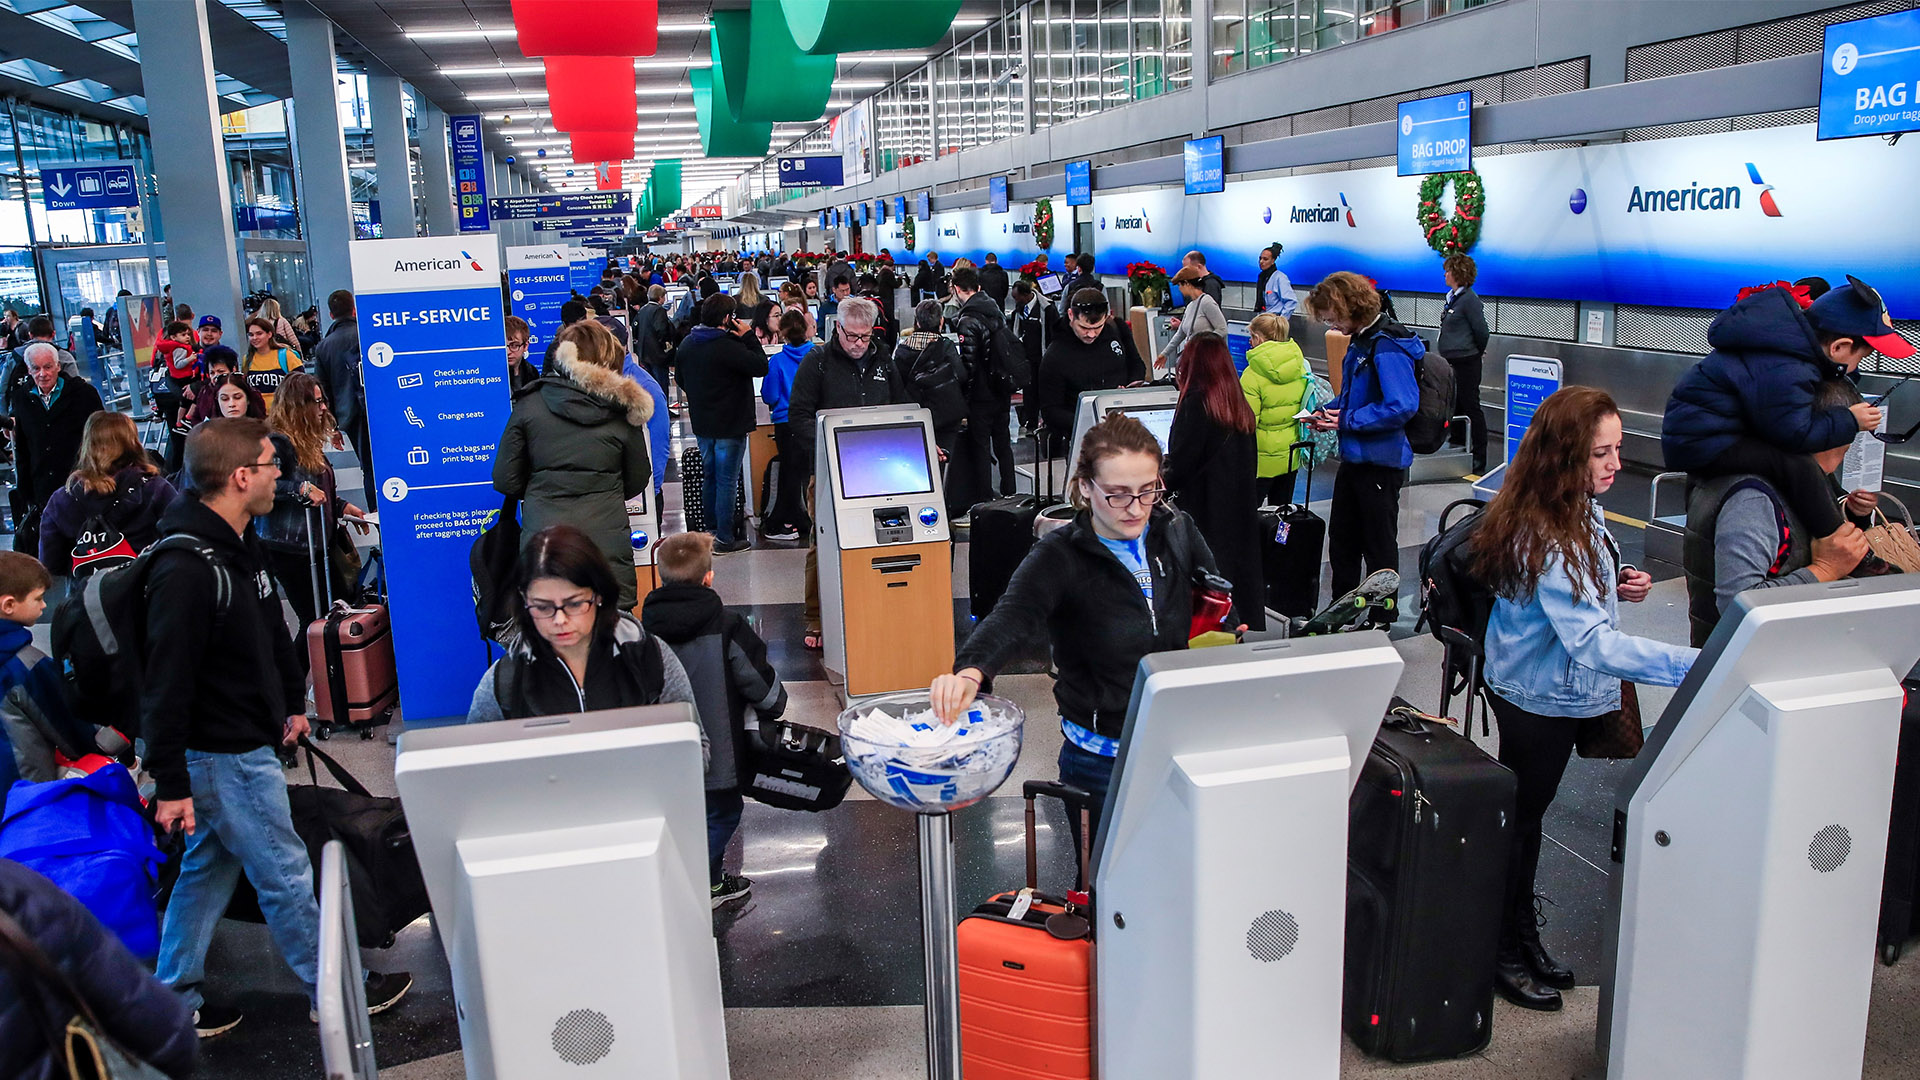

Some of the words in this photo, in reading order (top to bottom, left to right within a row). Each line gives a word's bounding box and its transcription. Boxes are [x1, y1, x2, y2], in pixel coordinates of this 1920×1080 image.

[1840, 55, 1848, 70] 2
[1855, 82, 1907, 111] BAG
[1854, 113, 1877, 126] Drop
[1877, 112, 1901, 125] your
[1412, 142, 1433, 159] BAG
[1435, 138, 1466, 157] DROP
[780, 159, 791, 172] C
[1204, 168, 1220, 182] DROP
[464, 196, 470, 204] 3
[1627, 181, 1741, 213] American
[465, 208, 471, 217] 5
[706, 207, 717, 215] 7A
[1289, 203, 1340, 223] American
[1115, 214, 1143, 229] American
[394, 258, 461, 273] American
[514, 274, 565, 285] SELF-SERVICE
[371, 306, 491, 328] SELF-SERVICE
[377, 352, 384, 363] 1
[433, 369, 465, 377] Check-in
[465, 367, 480, 375] and
[434, 378, 452, 388] print
[453, 377, 486, 387] boarding
[486, 376, 502, 384] pass
[437, 412, 465, 421] Change
[465, 411, 485, 419] seats
[441, 445, 463, 454] Check
[463, 444, 481, 453] bags
[481, 443, 496, 451] and
[442, 455, 460, 464] print
[460, 454, 474, 463] bag
[474, 453, 490, 462] tags
[391, 487, 400, 498] 2
[420, 511, 452, 521] checking
[414, 521, 444, 531] proceed
[444, 520, 453, 528] to
[454, 518, 471, 527] BAG
[471, 517, 493, 525] DROP
[416, 531, 433, 539] after
[434, 529, 461, 539] tagging
[461, 528, 478, 537] bags
